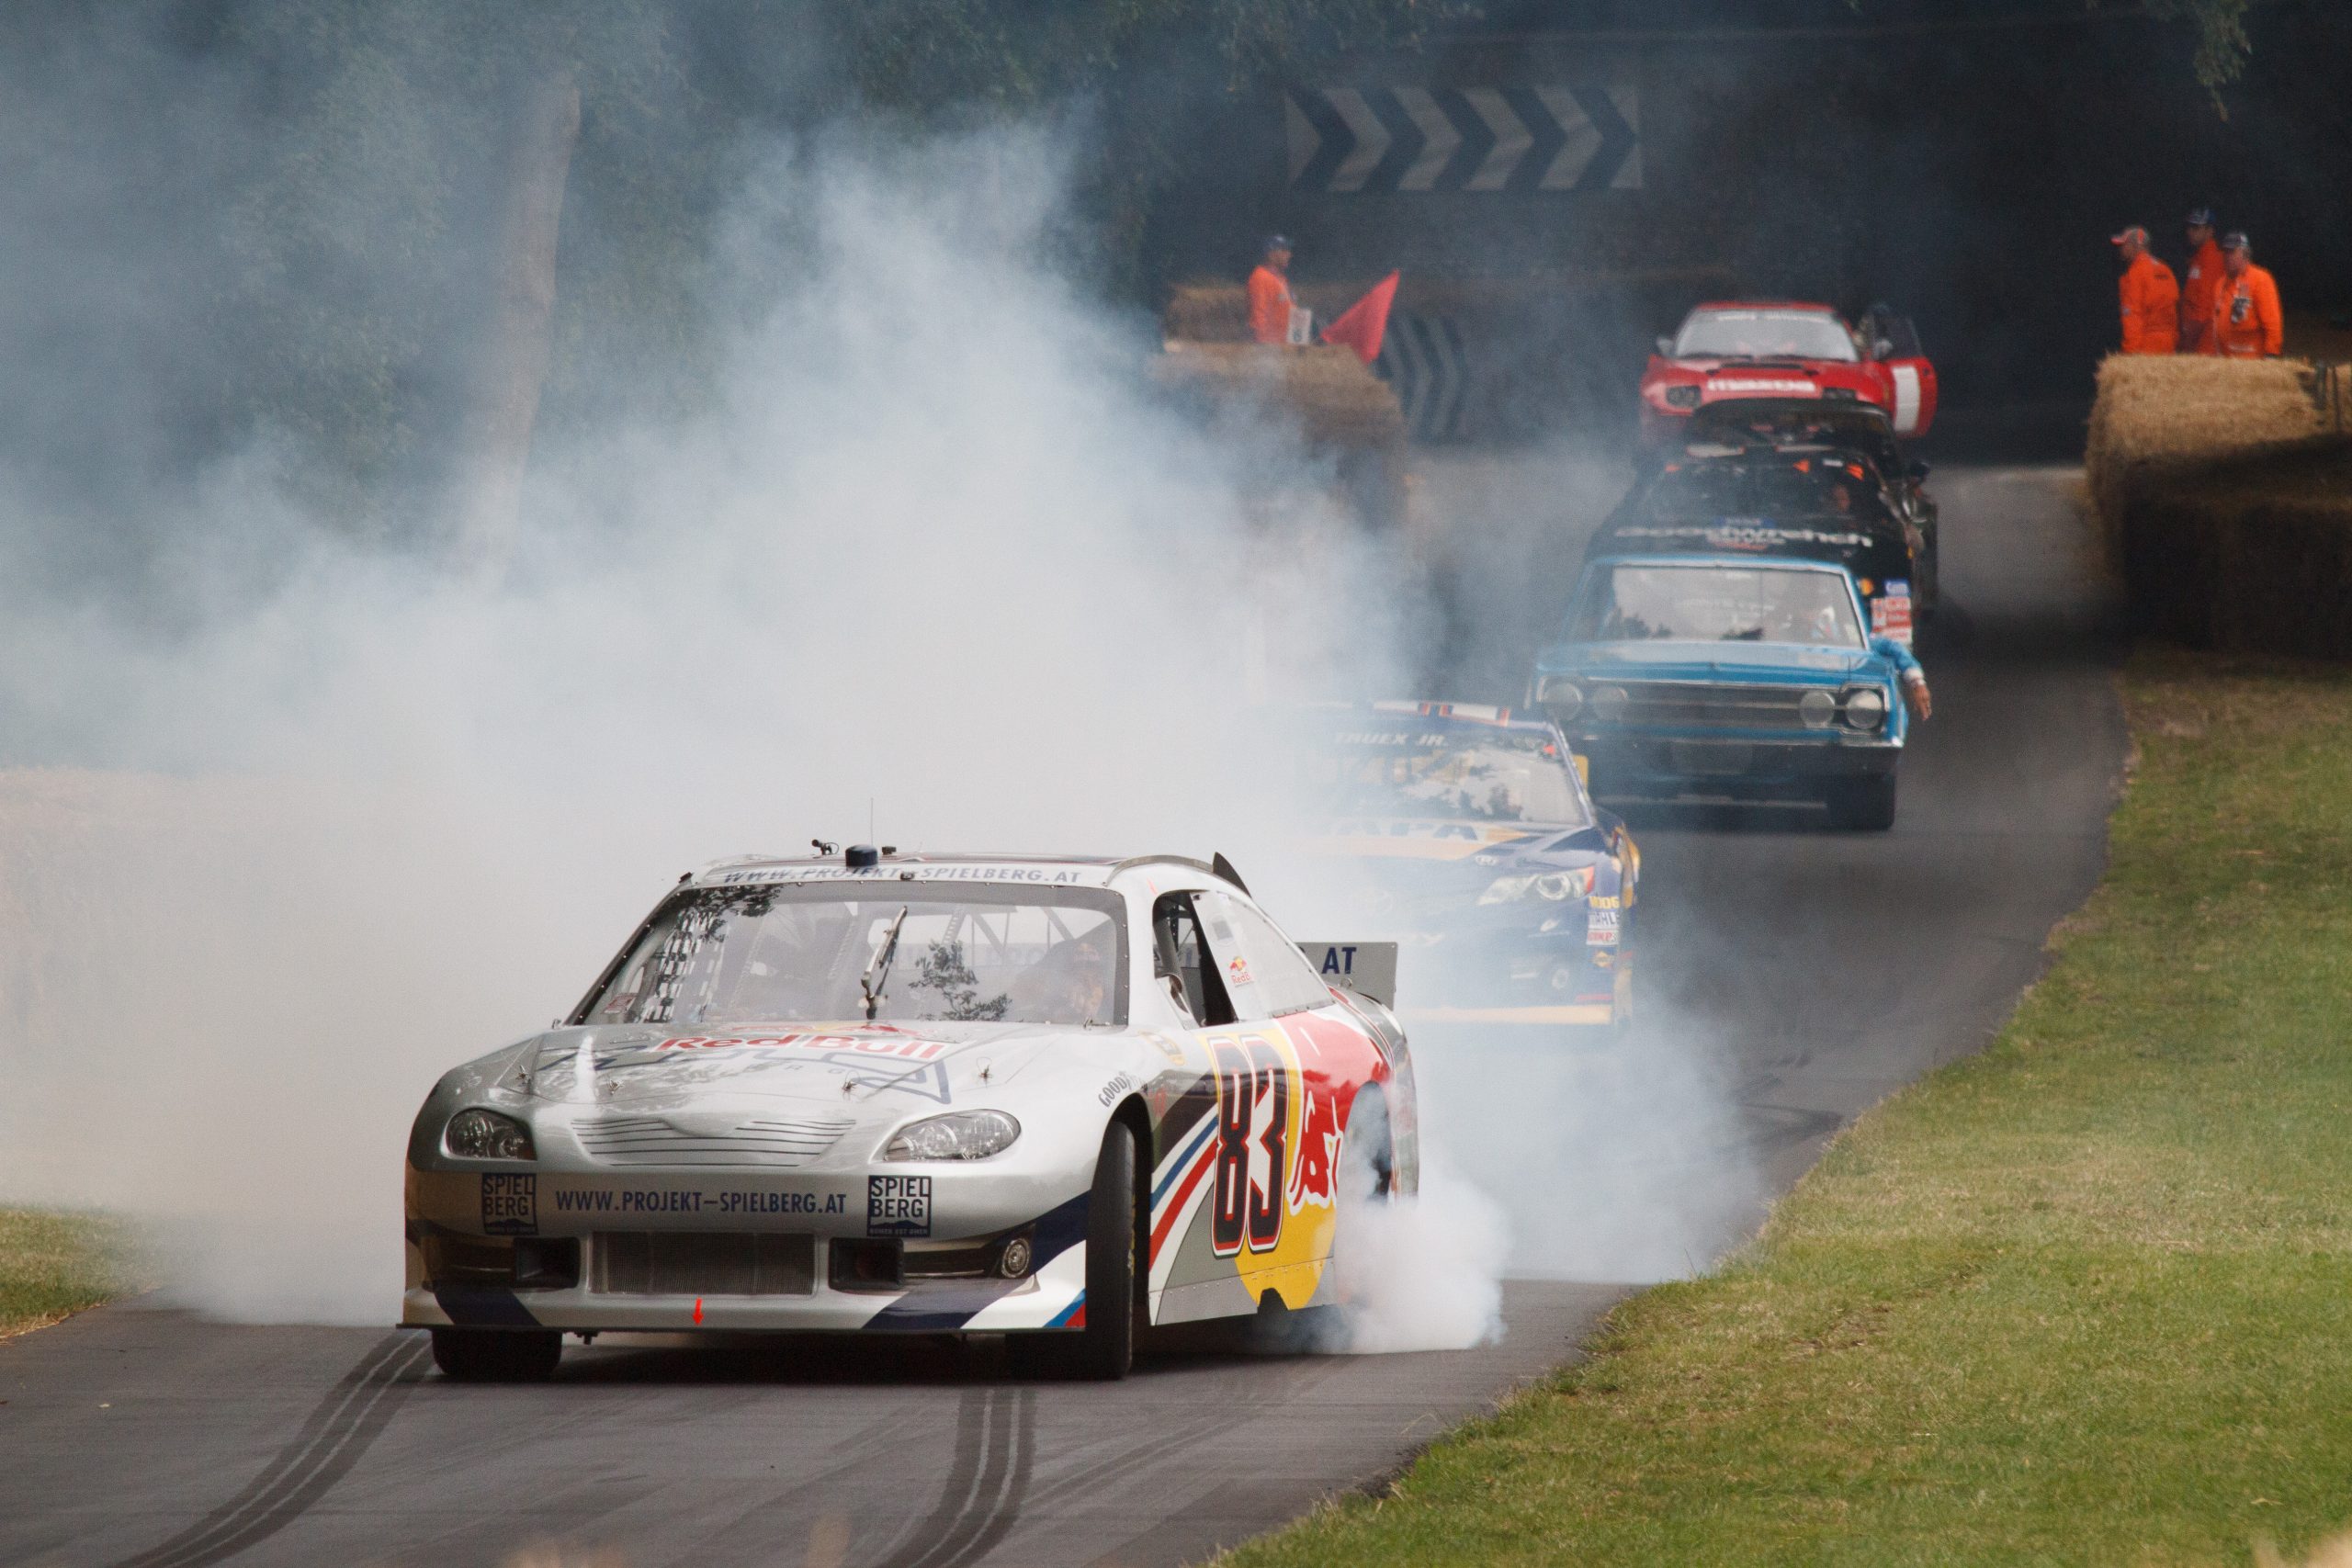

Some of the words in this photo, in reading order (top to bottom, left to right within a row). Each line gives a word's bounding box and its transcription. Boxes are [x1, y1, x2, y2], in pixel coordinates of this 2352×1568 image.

[656, 1033, 799, 1052] Red
[805, 1034, 946, 1059] Bull
[1206, 1032, 1288, 1258] 83
[483, 1175, 535, 1195] SPIEL
[871, 1176, 930, 1198] SPIEL
[483, 1196, 529, 1217] BERG
[871, 1199, 924, 1218] BERG
